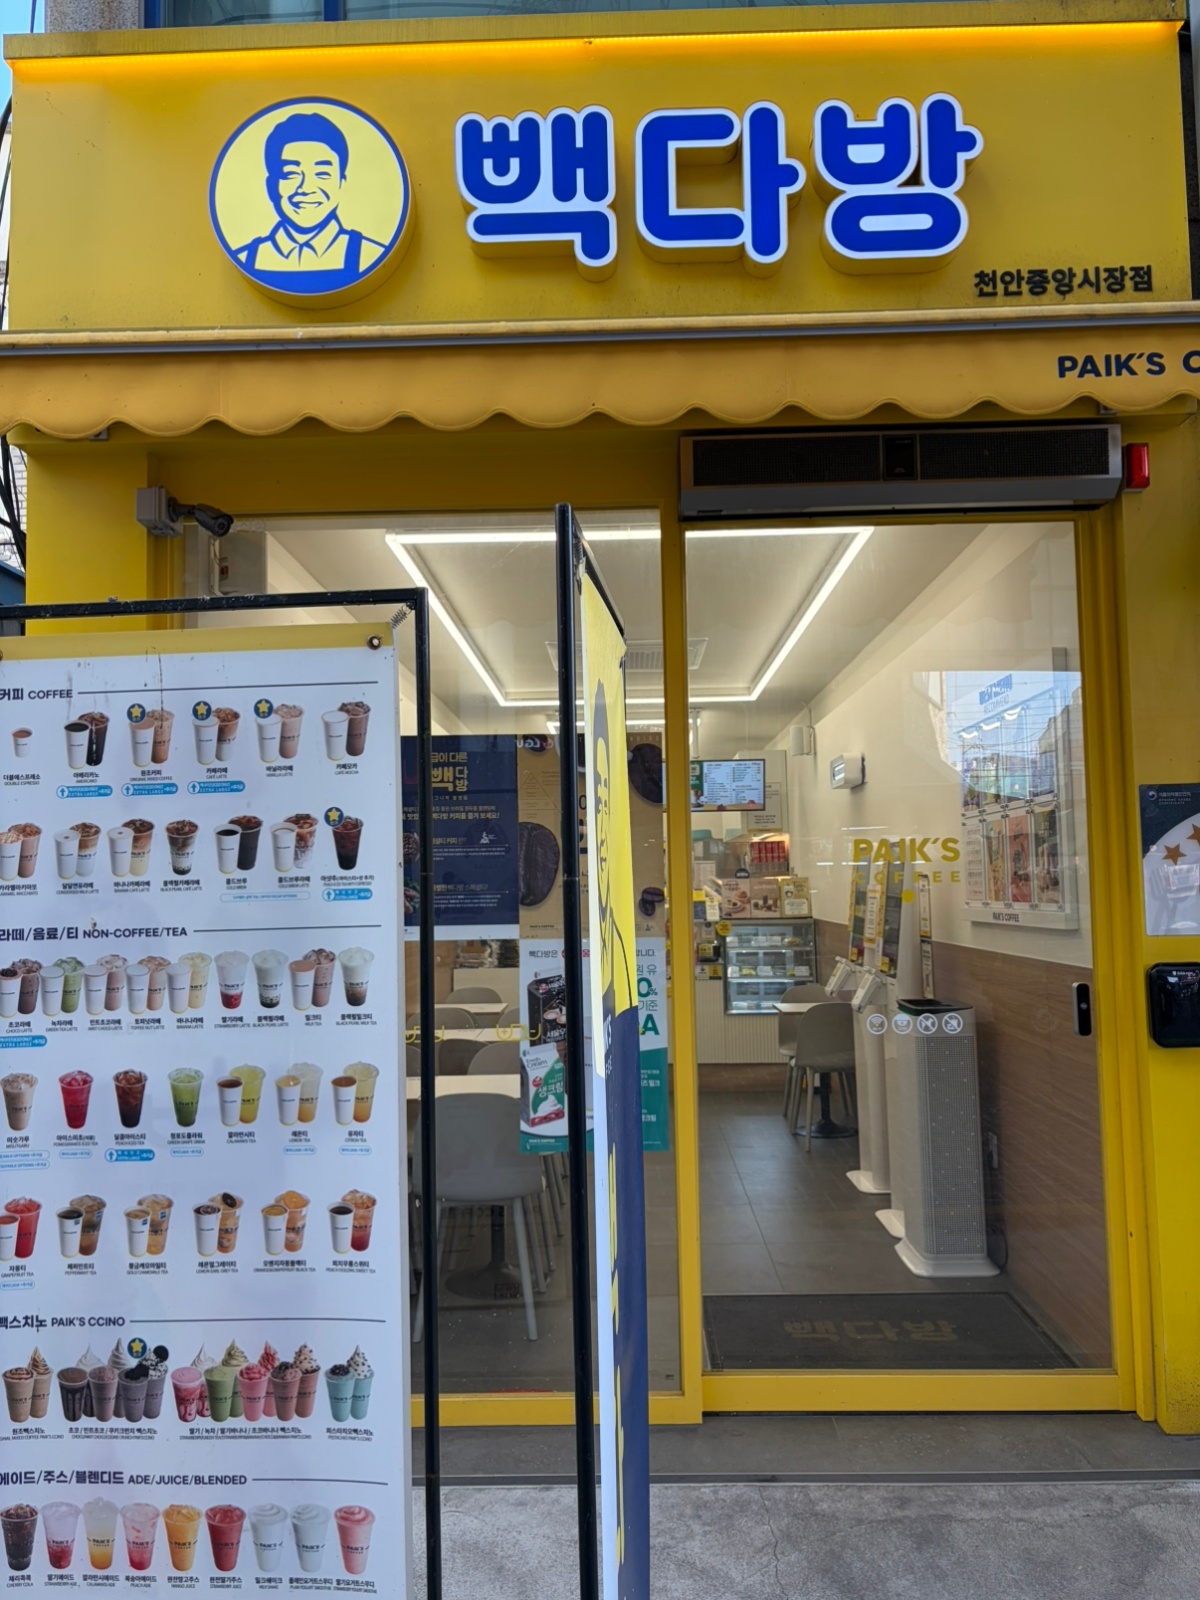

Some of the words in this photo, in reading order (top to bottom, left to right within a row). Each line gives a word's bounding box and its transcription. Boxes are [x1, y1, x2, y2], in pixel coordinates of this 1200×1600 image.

[454, 92, 984, 268] 빽다방
[974, 265, 1153, 297] 천안중앙시장점
[1057, 352, 1166, 378] PAIK'S
[0, 688, 24, 701] 커피
[28, 689, 73, 700] COFFEE
[449, 752, 468, 763] 다른
[853, 837, 960, 863] PAIK'S
[853, 871, 961, 883] COFFEE
[1005, 912, 1020, 922] COFFEE
[0, 927, 78, 941] 라떼/음료/티
[83, 927, 187, 939] NON-COFFEE/TEA
[529, 950, 558, 958] 빽다방은
[637, 977, 658, 998] 0%
[640, 1013, 660, 1036] A
[546, 1028, 567, 1039] 서울우
[525, 1056, 541, 1065] Fresh
[526, 1059, 548, 1069] Cream
[537, 1081, 564, 1098] 생크림
[51, 1317, 85, 1327] PAIK'S
[88, 1317, 125, 1326] CCINO
[0, 1470, 124, 1485] 에이드/주스/블렌디드
[128, 1475, 247, 1486] ADE/JUICE/BLENDED
